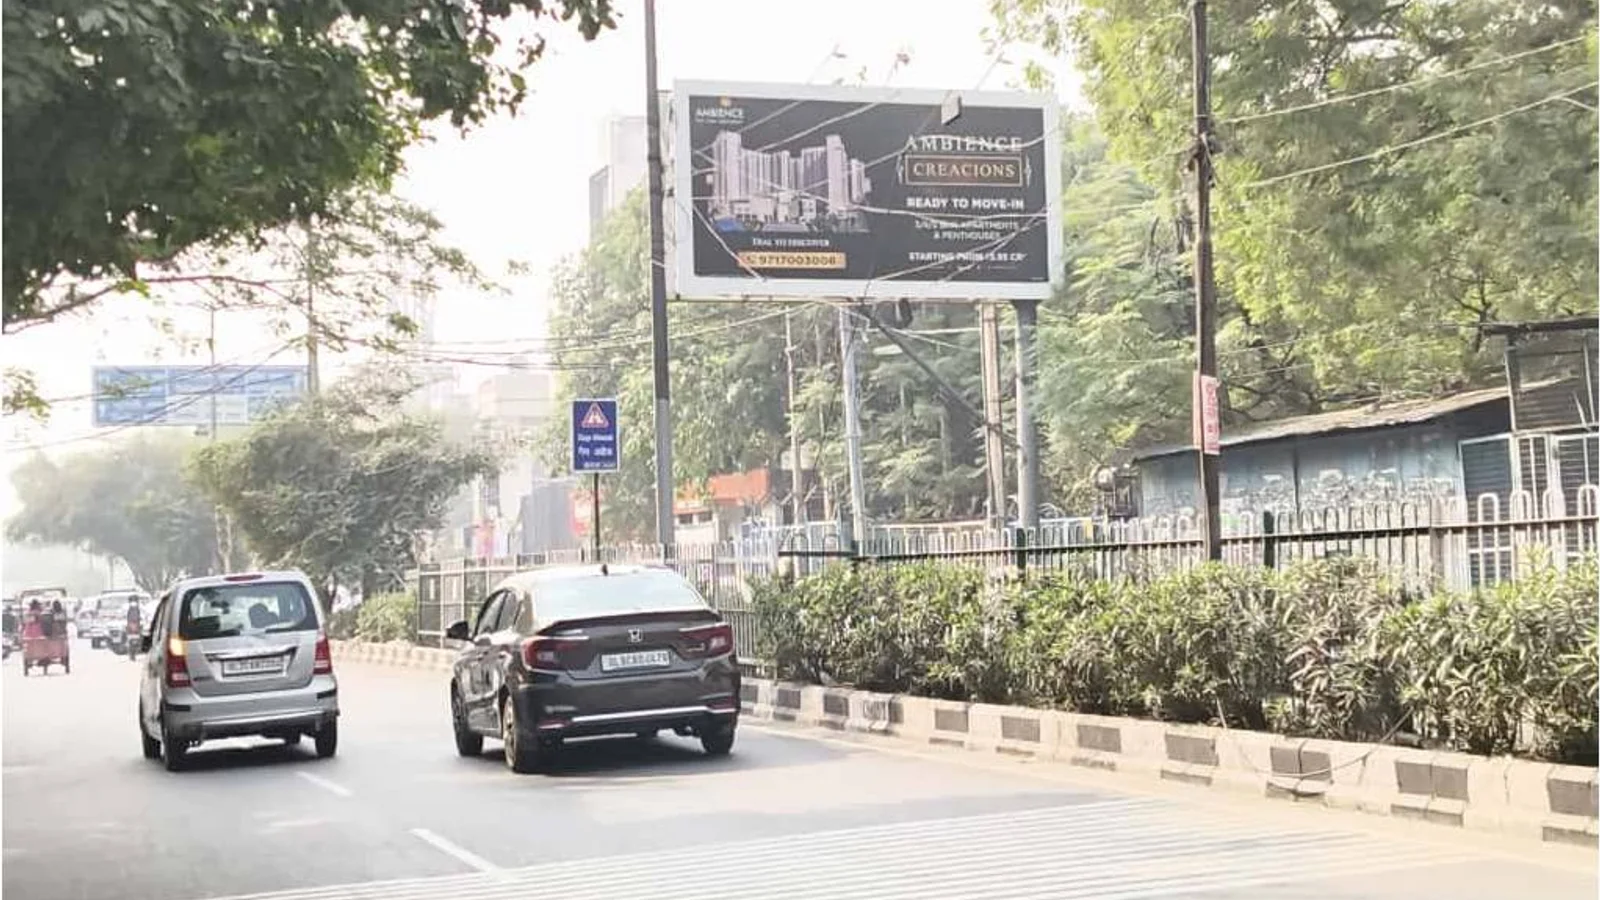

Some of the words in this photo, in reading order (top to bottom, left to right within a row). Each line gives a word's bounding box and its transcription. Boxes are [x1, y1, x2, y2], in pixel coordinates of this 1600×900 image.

[905, 135, 1022, 152] AMBIENCE
[912, 162, 1016, 178] CREACIONS
[906, 197, 948, 208] READY
[950, 198, 969, 208] TO
[971, 198, 1024, 210] MOVE-IN
